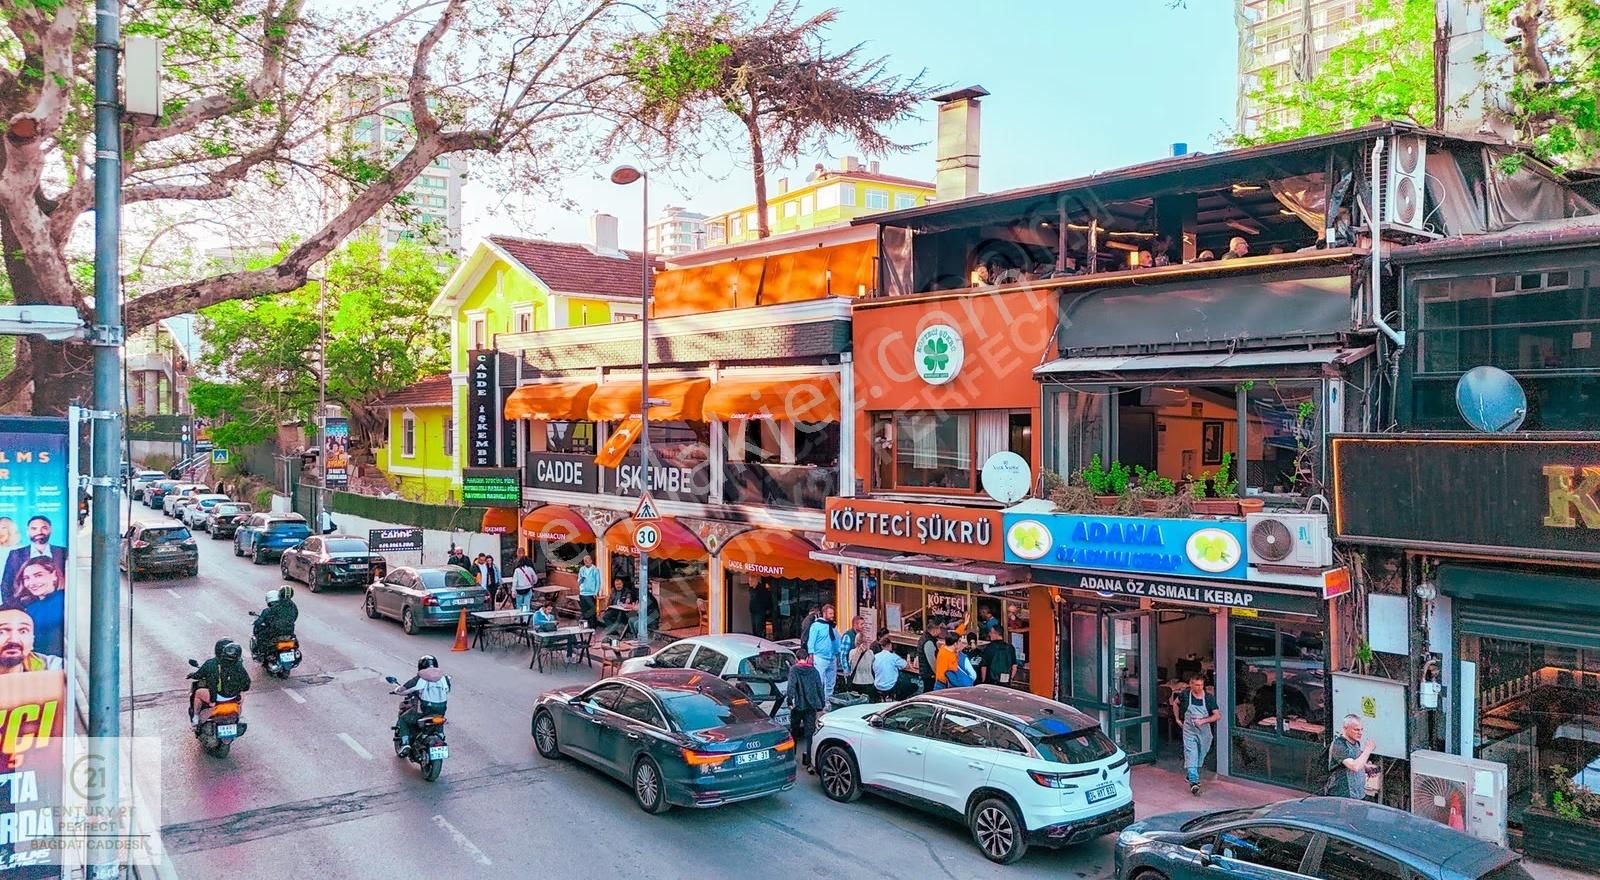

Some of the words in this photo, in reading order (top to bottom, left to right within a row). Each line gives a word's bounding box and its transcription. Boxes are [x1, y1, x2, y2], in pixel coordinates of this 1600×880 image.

[476, 355, 488, 396] CADDE
[475, 404, 489, 465] İŞKEMBE
[537, 459, 583, 485] CADDE
[638, 530, 657, 544] 30
[830, 506, 911, 538] KÖFTECİ
[917, 511, 991, 546] ŞÜKRÜ
[1072, 521, 1165, 546] ADANA
[744, 562, 784, 575] RESTORANT
[1079, 576, 1124, 592] ADANA
[1126, 578, 1145, 594] ÖZ
[1148, 584, 1200, 601] ASMALI
[1204, 590, 1253, 606] KEBAP
[0, 700, 58, 769] ÇI
